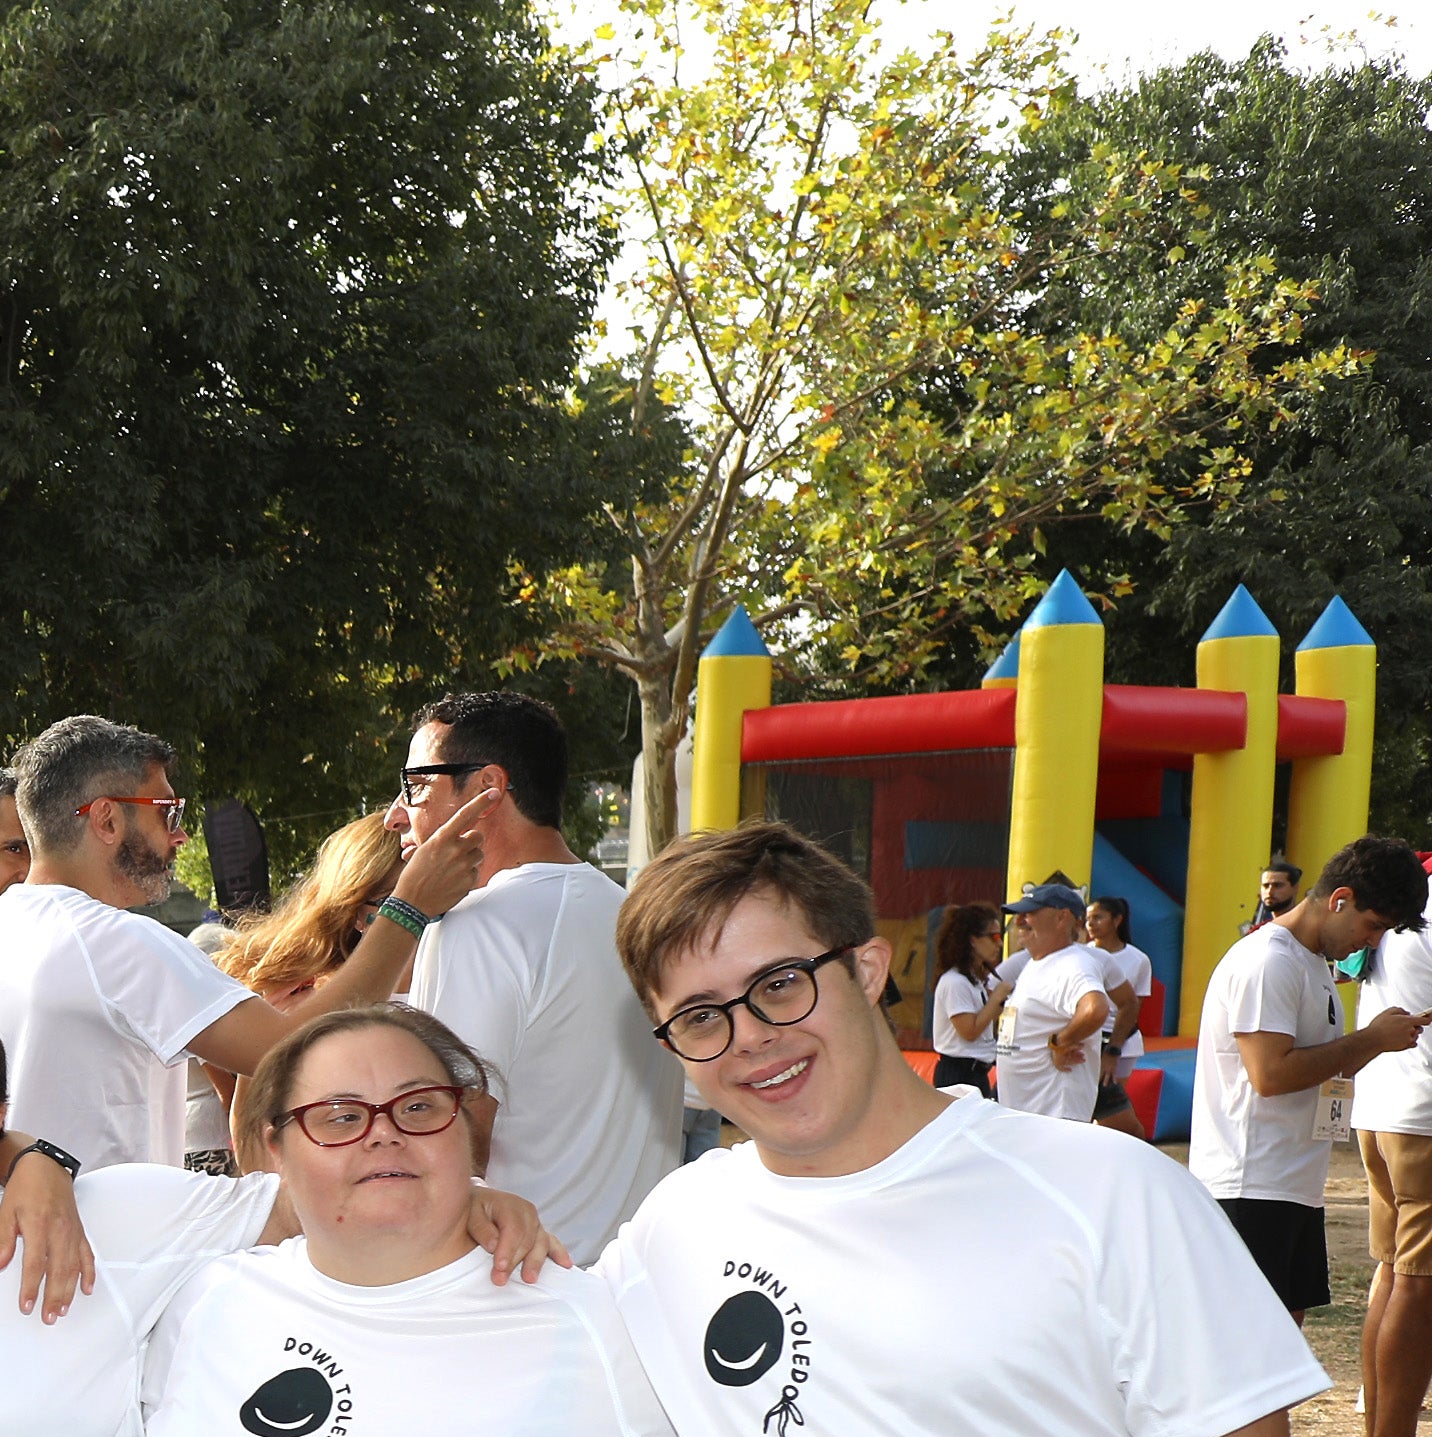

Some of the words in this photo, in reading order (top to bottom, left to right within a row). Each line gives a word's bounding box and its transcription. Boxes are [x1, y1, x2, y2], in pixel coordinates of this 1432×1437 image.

[1330, 1099, 1342, 1121] 64
[723, 1260, 788, 1299] DOWN
[781, 1303, 812, 1401] TOLEDO
[283, 1337, 344, 1379] DOWN
